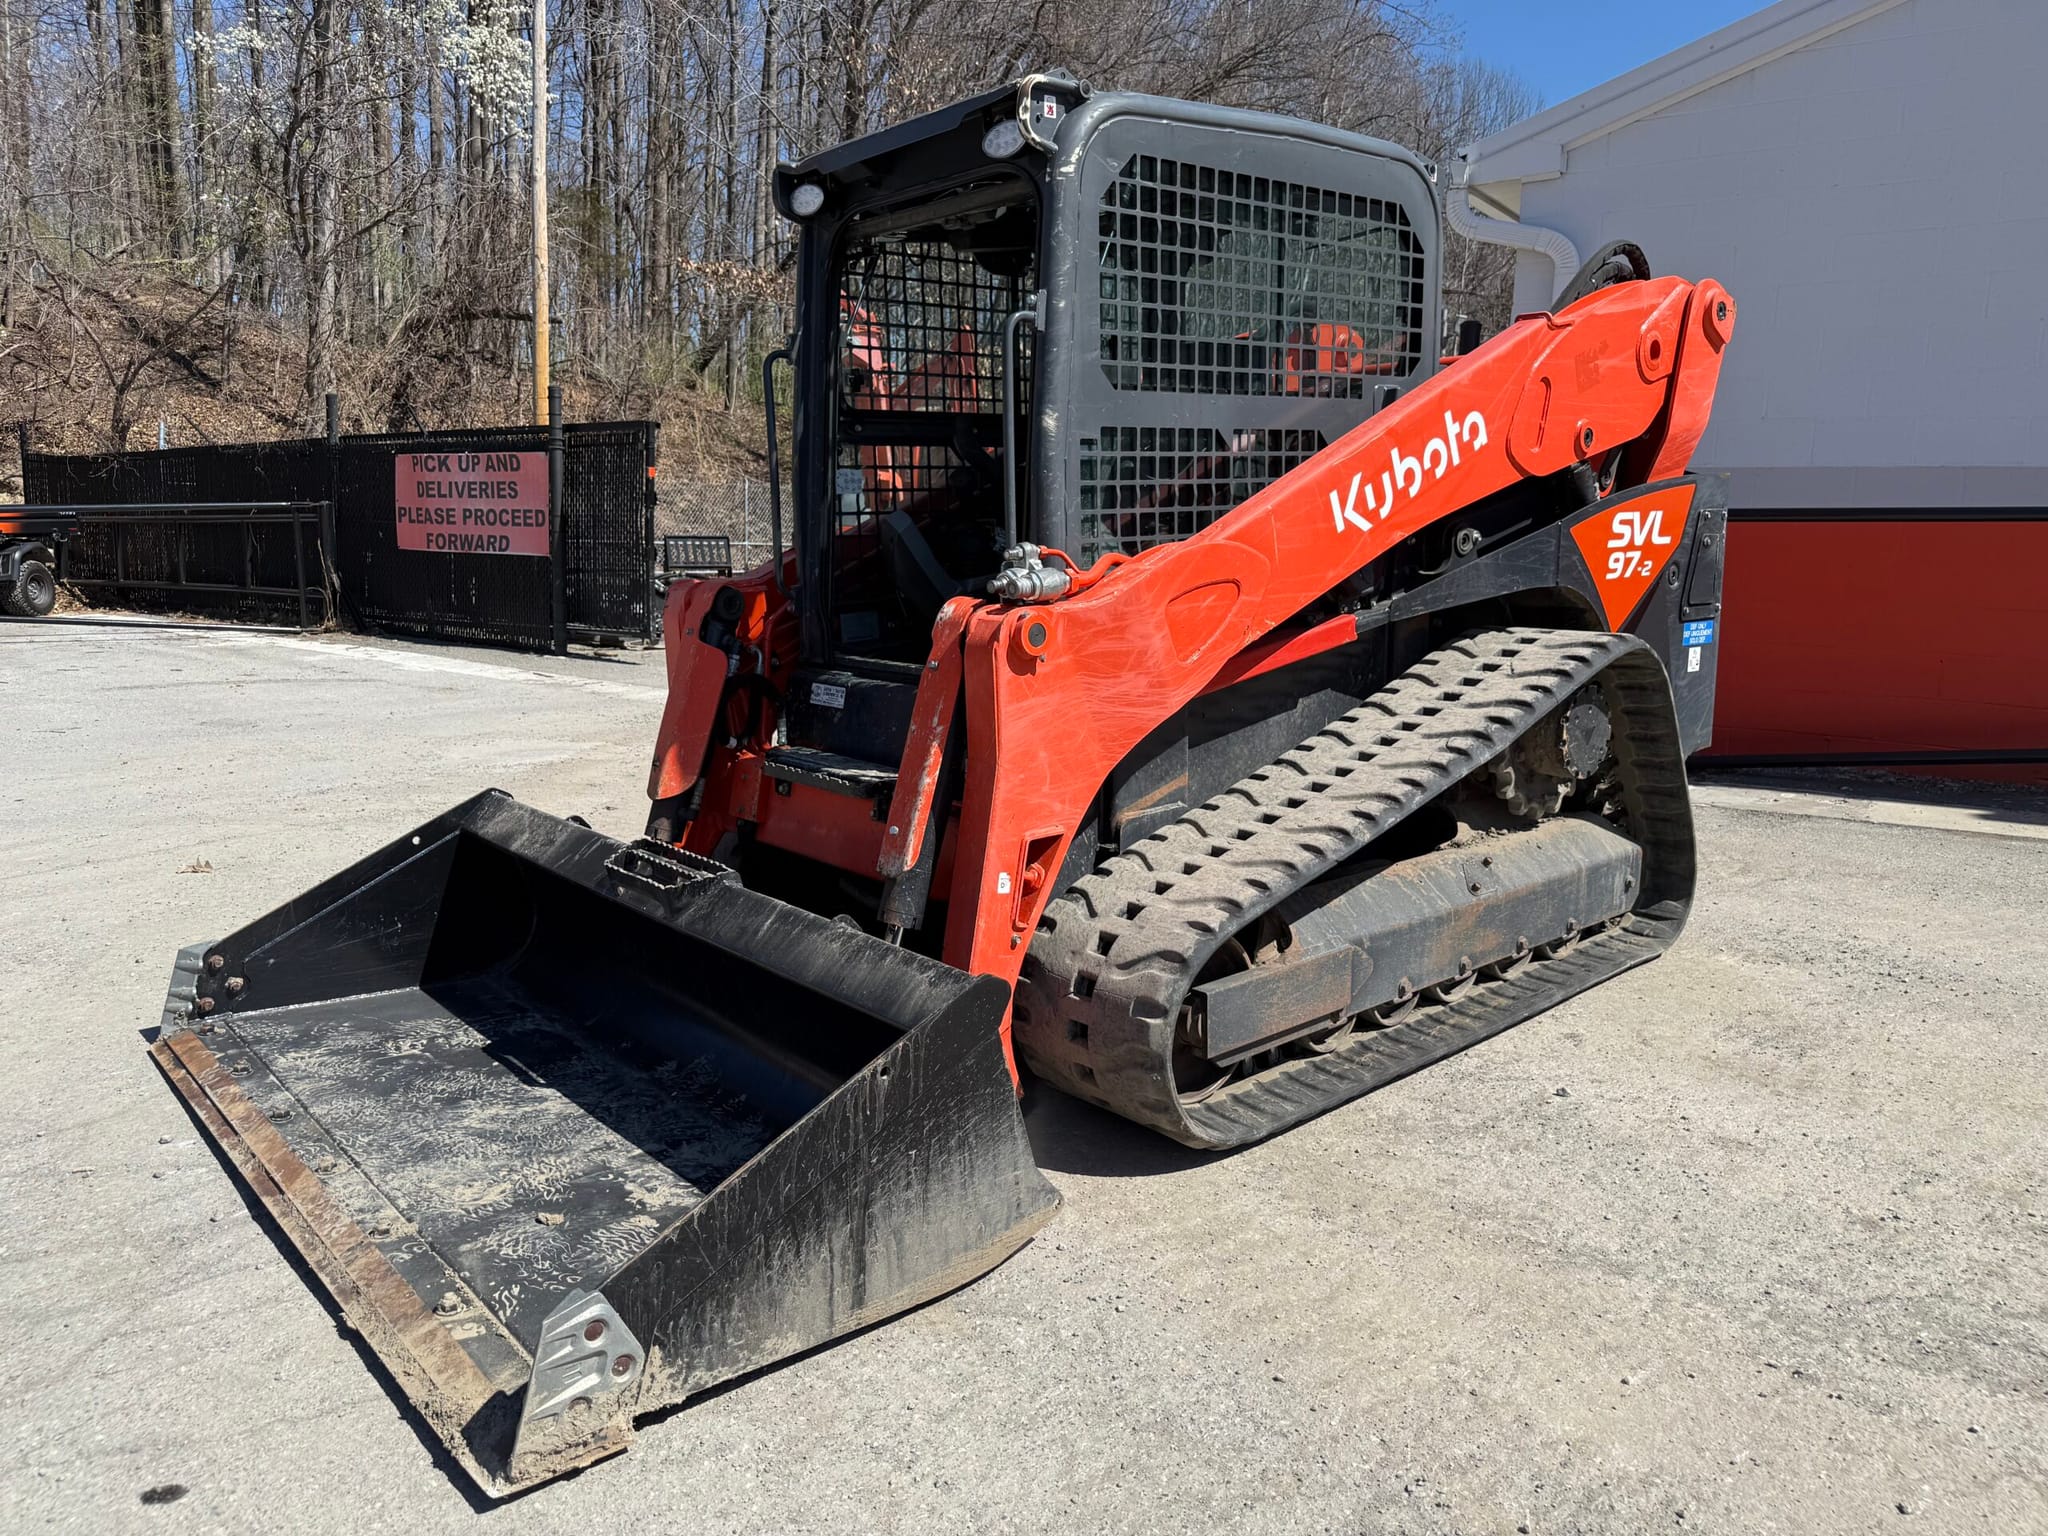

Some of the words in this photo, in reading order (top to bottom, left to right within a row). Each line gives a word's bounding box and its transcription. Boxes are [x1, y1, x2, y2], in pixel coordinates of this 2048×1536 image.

[412, 455, 451, 472] PICK
[457, 454, 480, 472] UP
[485, 453, 521, 472] AND
[1329, 409, 1488, 534] Kubota
[416, 480, 519, 499] DELIVERIES
[397, 506, 457, 525] PLEASE
[462, 508, 546, 527] PROCEED
[1607, 510, 1672, 548] SVL
[426, 532, 510, 552] FORWARD
[1605, 551, 1653, 580] 97-2
